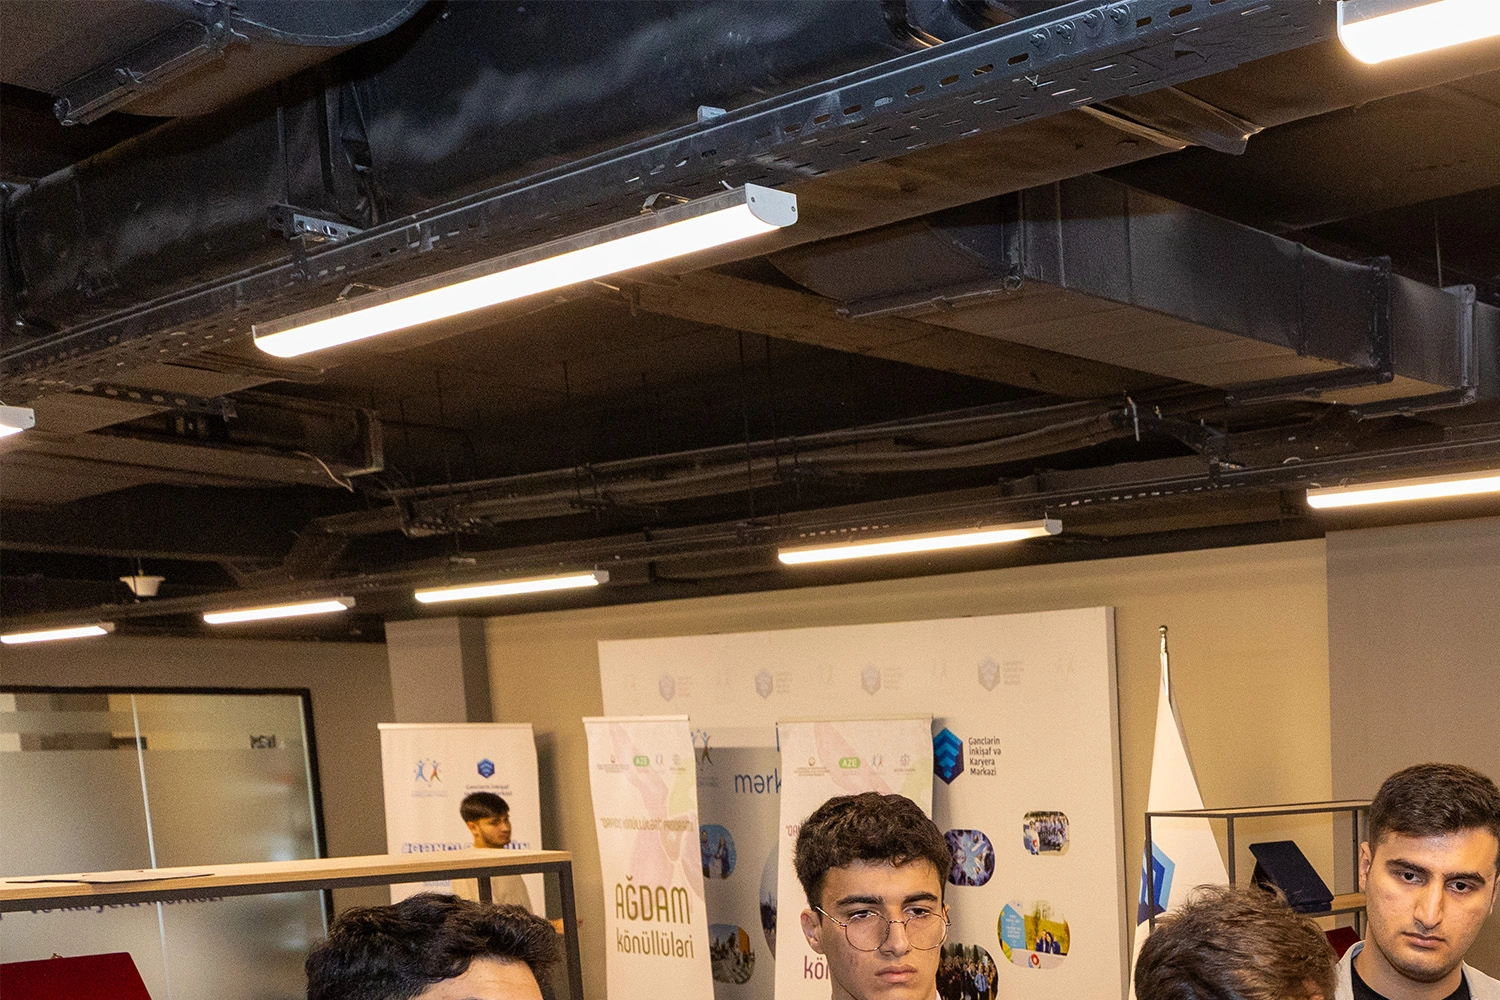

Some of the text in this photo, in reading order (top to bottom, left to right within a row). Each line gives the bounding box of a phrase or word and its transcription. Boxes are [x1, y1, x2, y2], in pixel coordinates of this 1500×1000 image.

[968, 736, 1001, 746] Gənclərin
[841, 758, 858, 768] AZE
[969, 757, 996, 768] Karyera
[970, 766, 997, 777] Mərkəzi
[615, 875, 691, 925] AĞDAM
[616, 927, 695, 959] könüllüləri
